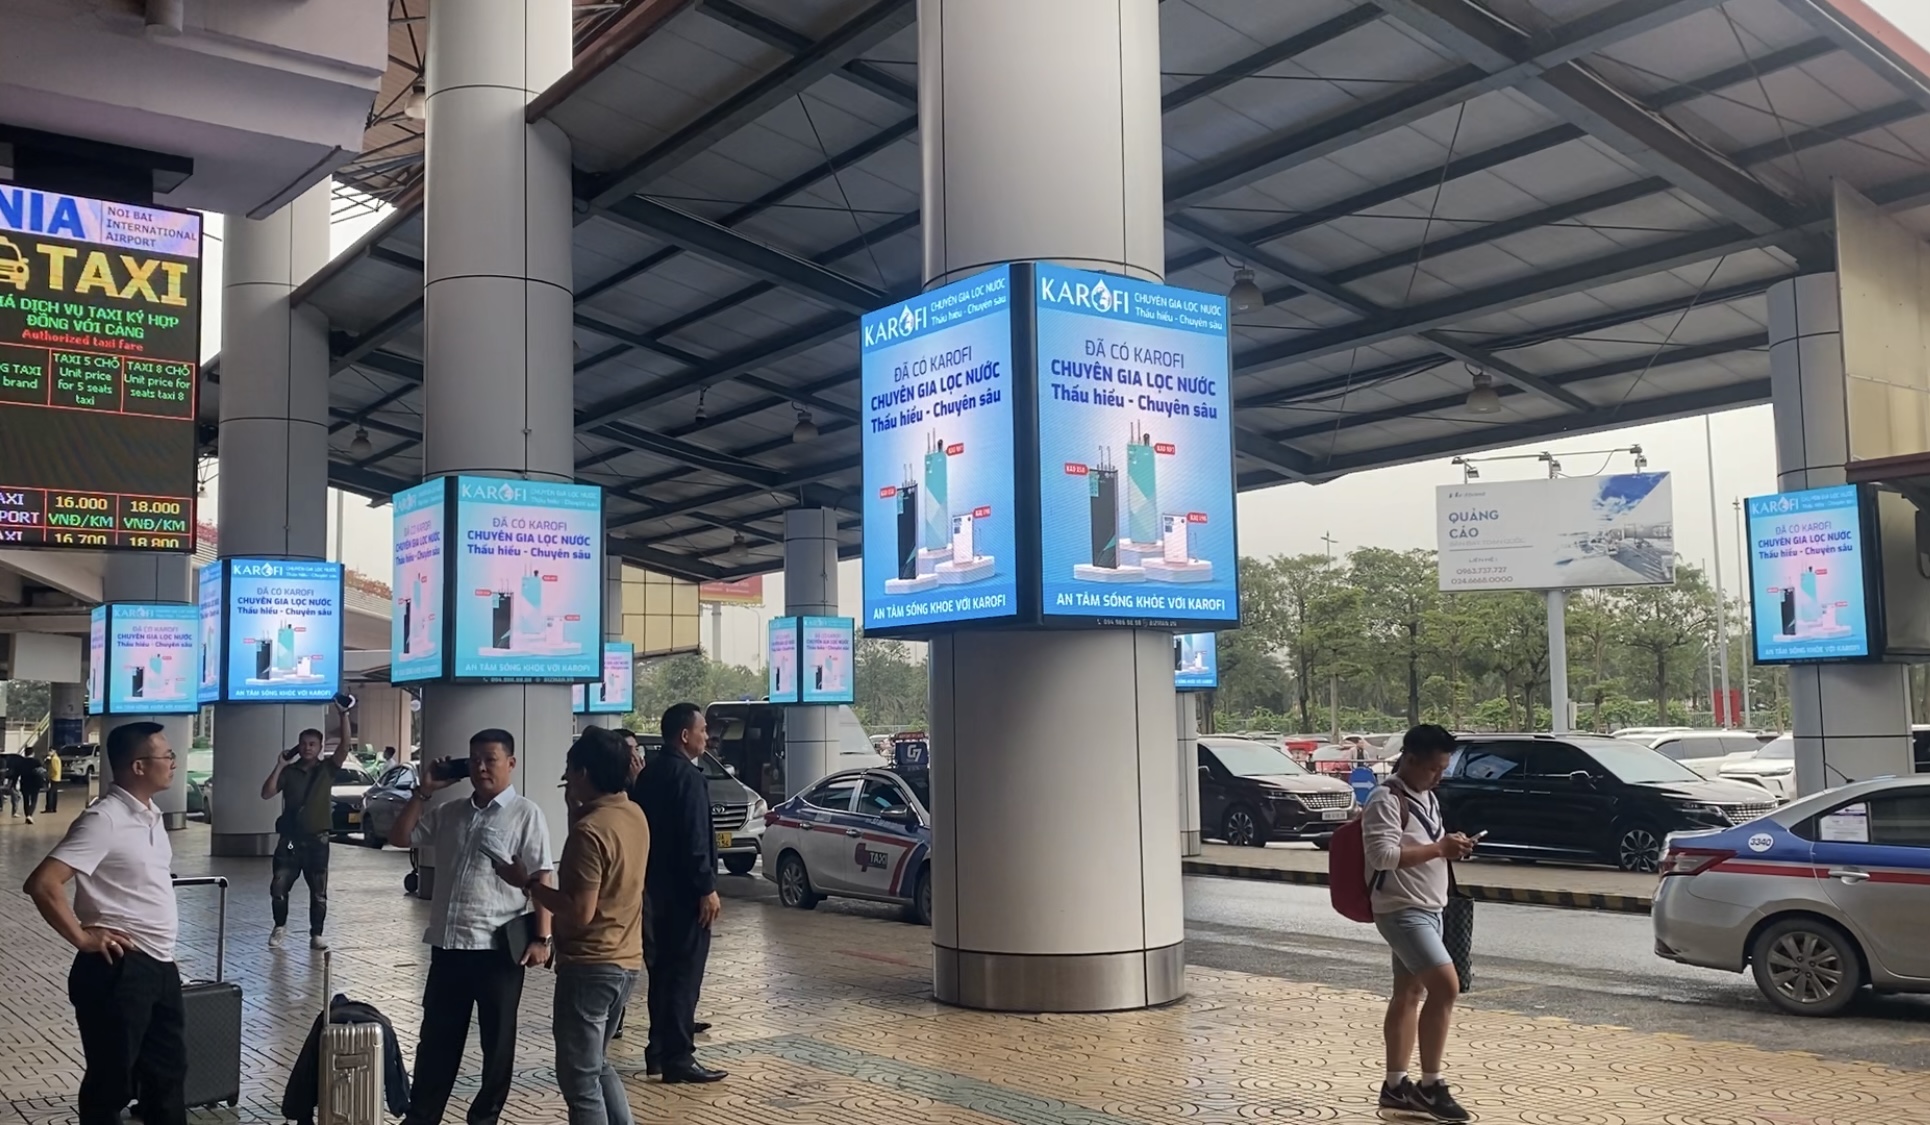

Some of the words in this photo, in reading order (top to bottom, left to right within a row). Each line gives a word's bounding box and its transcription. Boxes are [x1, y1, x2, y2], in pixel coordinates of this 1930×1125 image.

[108, 206, 129, 218] NOI
[134, 212, 152, 221] BAI
[107, 219, 196, 241] INTERNATIONAL
[106, 232, 156, 247] AIRPORT
[36, 244, 187, 306] TAXI
[958, 290, 970, 303] GIA
[1041, 277, 1129, 314] KAROFI
[1169, 298, 1182, 310] GIA
[20, 299, 59, 313] DỊCH
[64, 304, 83, 317] VỤ
[88, 307, 123, 322] TAXI
[127, 309, 144, 323] KÝ
[148, 314, 179, 329] HỢP
[73, 316, 100, 333] VỚI
[865, 304, 927, 346] KAROFI
[22, 329, 90, 346] Authorized
[93, 336, 116, 349] taxi
[118, 339, 143, 351] fare
[53, 353, 81, 364] TAXI
[85, 356, 90, 365] 5
[1085, 338, 1105, 358] ĐÃ
[1110, 342, 1129, 361] CÓ
[1134, 346, 1184, 369] KAROFI
[13, 365, 42, 376] TAXI
[127, 361, 153, 373] TAXI
[156, 365, 162, 374] 8
[894, 358, 910, 382] ĐÃ
[913, 355, 927, 377] CÓ
[931, 346, 972, 371] KAROFI
[59, 367, 82, 378] Unit
[85, 371, 112, 382] price
[124, 374, 144, 384] Unit
[148, 378, 173, 388] price
[176, 379, 190, 389] for
[1051, 358, 1112, 383] CHUYÊN
[1117, 369, 1142, 387] GIA
[1147, 373, 1173, 394] LỌC
[1177, 373, 1216, 396] NƯỚC
[3, 376, 37, 389] brand
[58, 379, 74, 389] for
[78, 382, 84, 391] 5
[87, 383, 112, 394] seats
[871, 385, 914, 411] CHUYÊN
[918, 380, 937, 399] GIA
[941, 372, 962, 395] LỌC
[966, 361, 1000, 385] NƯỚC
[76, 394, 95, 405] taxi
[131, 388, 155, 398] seats
[158, 390, 175, 400] taxi
[178, 392, 184, 401] 8
[1051, 383, 1089, 403] Thấu
[1093, 387, 1124, 408] hiểu
[1138, 395, 1189, 418] Chuyên
[1193, 402, 1217, 419] sâu
[871, 411, 897, 433] Thấu
[900, 405, 923, 426] hiểu
[933, 394, 976, 417] Chuyên
[979, 388, 1001, 406] sâu
[461, 483, 526, 502] KAROFI
[56, 496, 108, 511] 16.000
[131, 501, 180, 514] 18.000
[1752, 496, 1799, 515] KAROFI
[48, 513, 113, 528] VNĐ/KM
[124, 517, 185, 531] VNĐ/KM
[1449, 508, 1499, 523] QUẢNG
[492, 516, 508, 528] ĐÃ
[511, 517, 526, 529] CÓ
[529, 520, 567, 531] KAROFI
[1802, 521, 1831, 532] KAROFI
[467, 528, 513, 542] CHUYÊN
[516, 533, 535, 543] GIA
[538, 534, 558, 547] LỌC
[561, 534, 590, 546] NƯỚC
[1449, 526, 1479, 539] CÁO
[1758, 537, 1791, 548] CHUYÊN
[1793, 535, 1807, 544] GIA
[467, 544, 495, 555] Thấu
[531, 547, 570, 560] Chuyên
[573, 549, 590, 559] sâu
[1759, 549, 1778, 559] Thấu
[233, 562, 283, 576] KAROFI
[284, 588, 314, 596] KAROFI
[237, 596, 272, 605] CHUYÊN
[874, 607, 885, 620] AN
[906, 600, 928, 616] SỐNG
[973, 594, 1006, 609] KAROFI
[1057, 593, 1072, 606] AN
[1076, 591, 1100, 606] TÂM
[1103, 591, 1133, 608] SỐNG
[1168, 595, 1186, 609] VỚI
[1188, 598, 1225, 611] KAROFI
[1750, 837, 1772, 847] 3340
